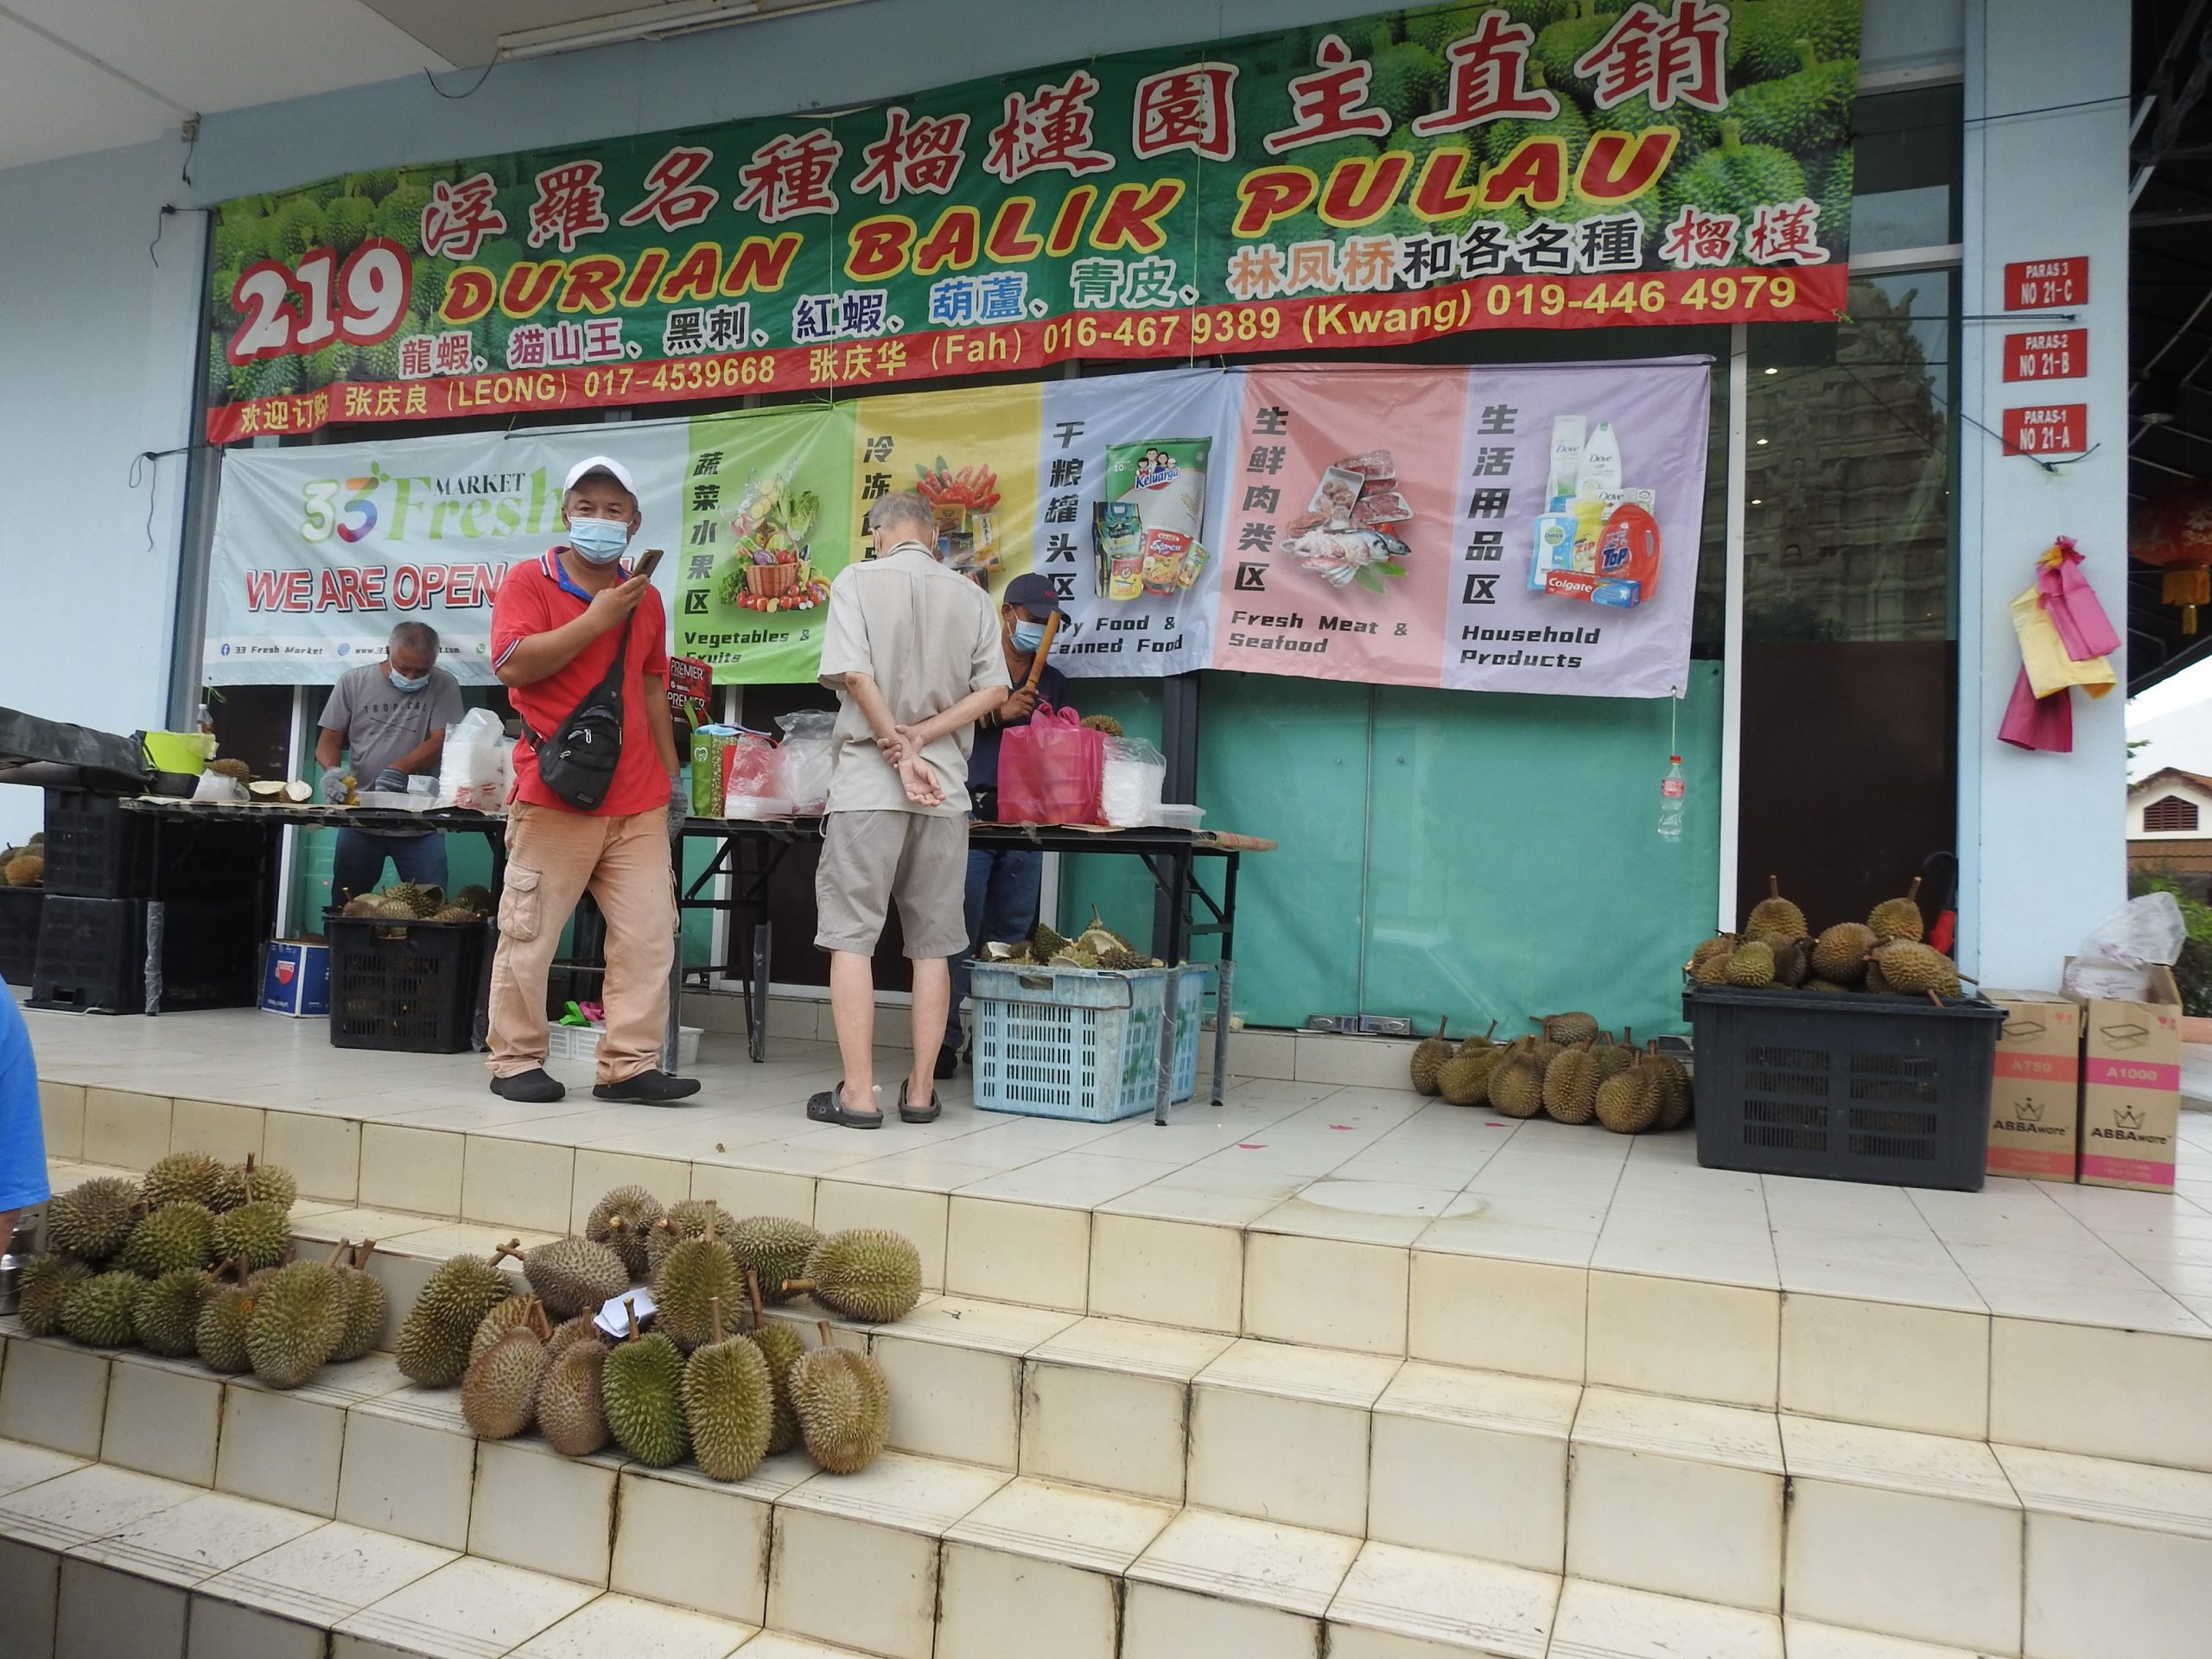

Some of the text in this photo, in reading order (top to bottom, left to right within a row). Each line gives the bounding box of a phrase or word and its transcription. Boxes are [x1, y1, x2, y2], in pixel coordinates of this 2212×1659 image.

[439, 126, 1680, 324] DURIAN BALIK PULAU
[2026, 263, 2069, 278] PARAS 3
[227, 238, 412, 365] 219
[2021, 279, 2072, 304] NO 21-C
[810, 276, 1796, 383] 张庆华 (Fah) 016-467 9389 (Kwang) 019-446 4979
[2025, 334, 2069, 350] PARAS-2
[2019, 352, 2069, 377] NO 21-B
[240, 355, 775, 433] 欢迎订购 张庆良 (LEONG) 017-4539668
[2024, 410, 2066, 424] PARAS-1
[2019, 426, 2070, 449] NO 21-A
[434, 474, 525, 496] MARKET
[1135, 468, 1179, 489] Keluarga
[384, 466, 568, 541] Fresh
[1234, 406, 1289, 591] 生鲜肉类区
[1463, 404, 1518, 604] 生活用品区
[1599, 491, 1624, 500] Dove
[684, 452, 723, 614] 蔬菜水果区
[245, 563, 507, 612] WE ARE OPEN
[1548, 578, 1592, 593] Colgate
[1056, 615, 1175, 638] ry Food &
[1231, 610, 1407, 636] Fresh Meat &
[684, 629, 810, 648] Vegetables &
[1137, 634, 1183, 652] Food
[1229, 632, 1328, 653] Seafood
[1462, 626, 1599, 644] Household
[251, 645, 279, 654] Fresh
[284, 646, 323, 655] Market
[1460, 651, 1581, 667] Products
[671, 660, 703, 680] PREMIER
[2012, 1060, 2052, 1072] A750
[2107, 1066, 2157, 1081] A1000
